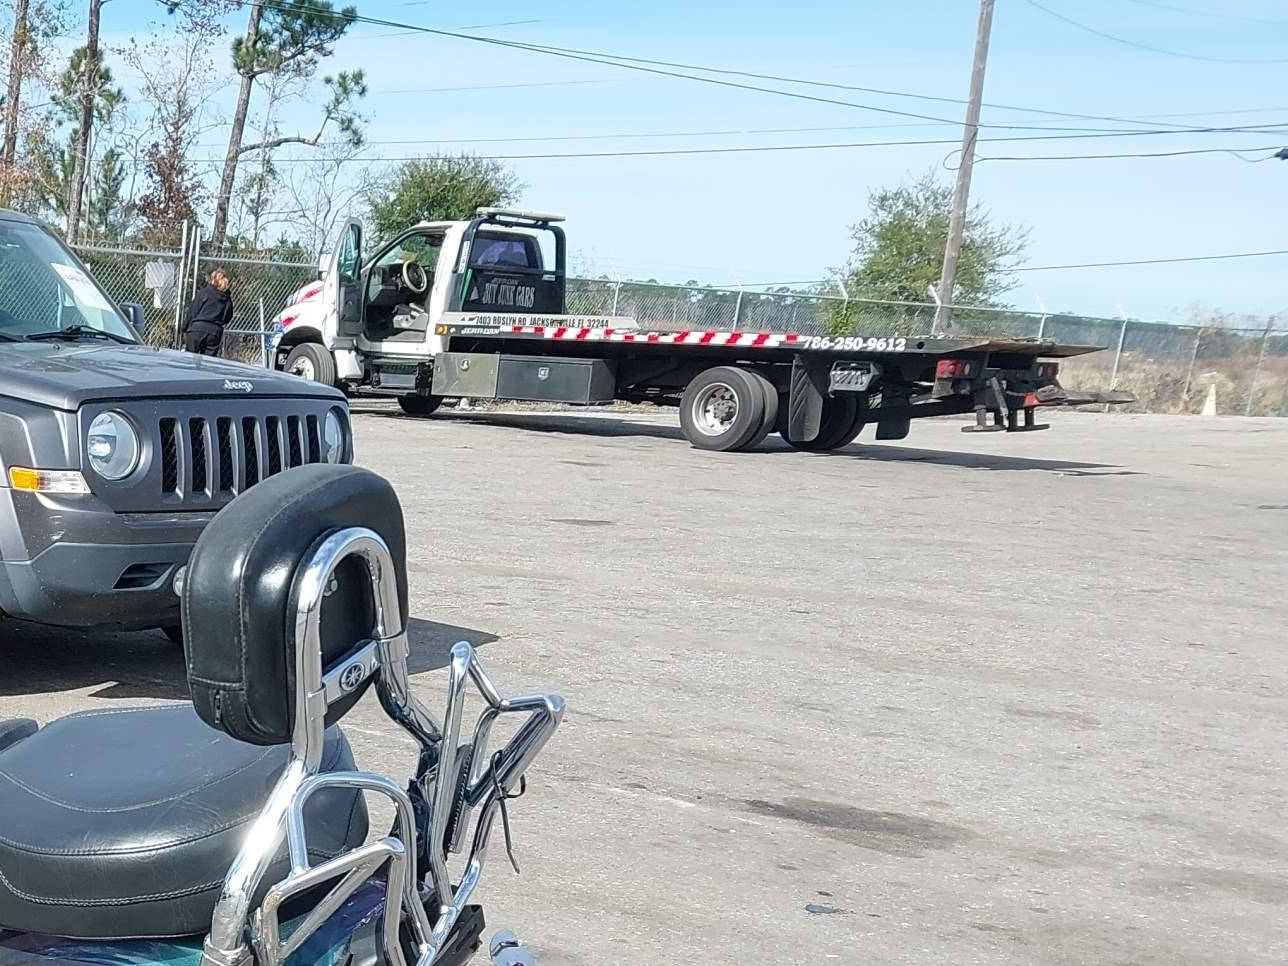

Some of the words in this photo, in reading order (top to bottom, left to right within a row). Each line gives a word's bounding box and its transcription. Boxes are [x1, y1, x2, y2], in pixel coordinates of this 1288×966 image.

[516, 286, 535, 308] CARS
[492, 316, 516, 326] ROSLYN
[529, 317, 576, 328] JACKSOLLE
[578, 319, 585, 329] FL
[587, 319, 609, 329] 32244
[803, 335, 906, 351] 786-250-9612
[224, 379, 253, 393] Jeep
